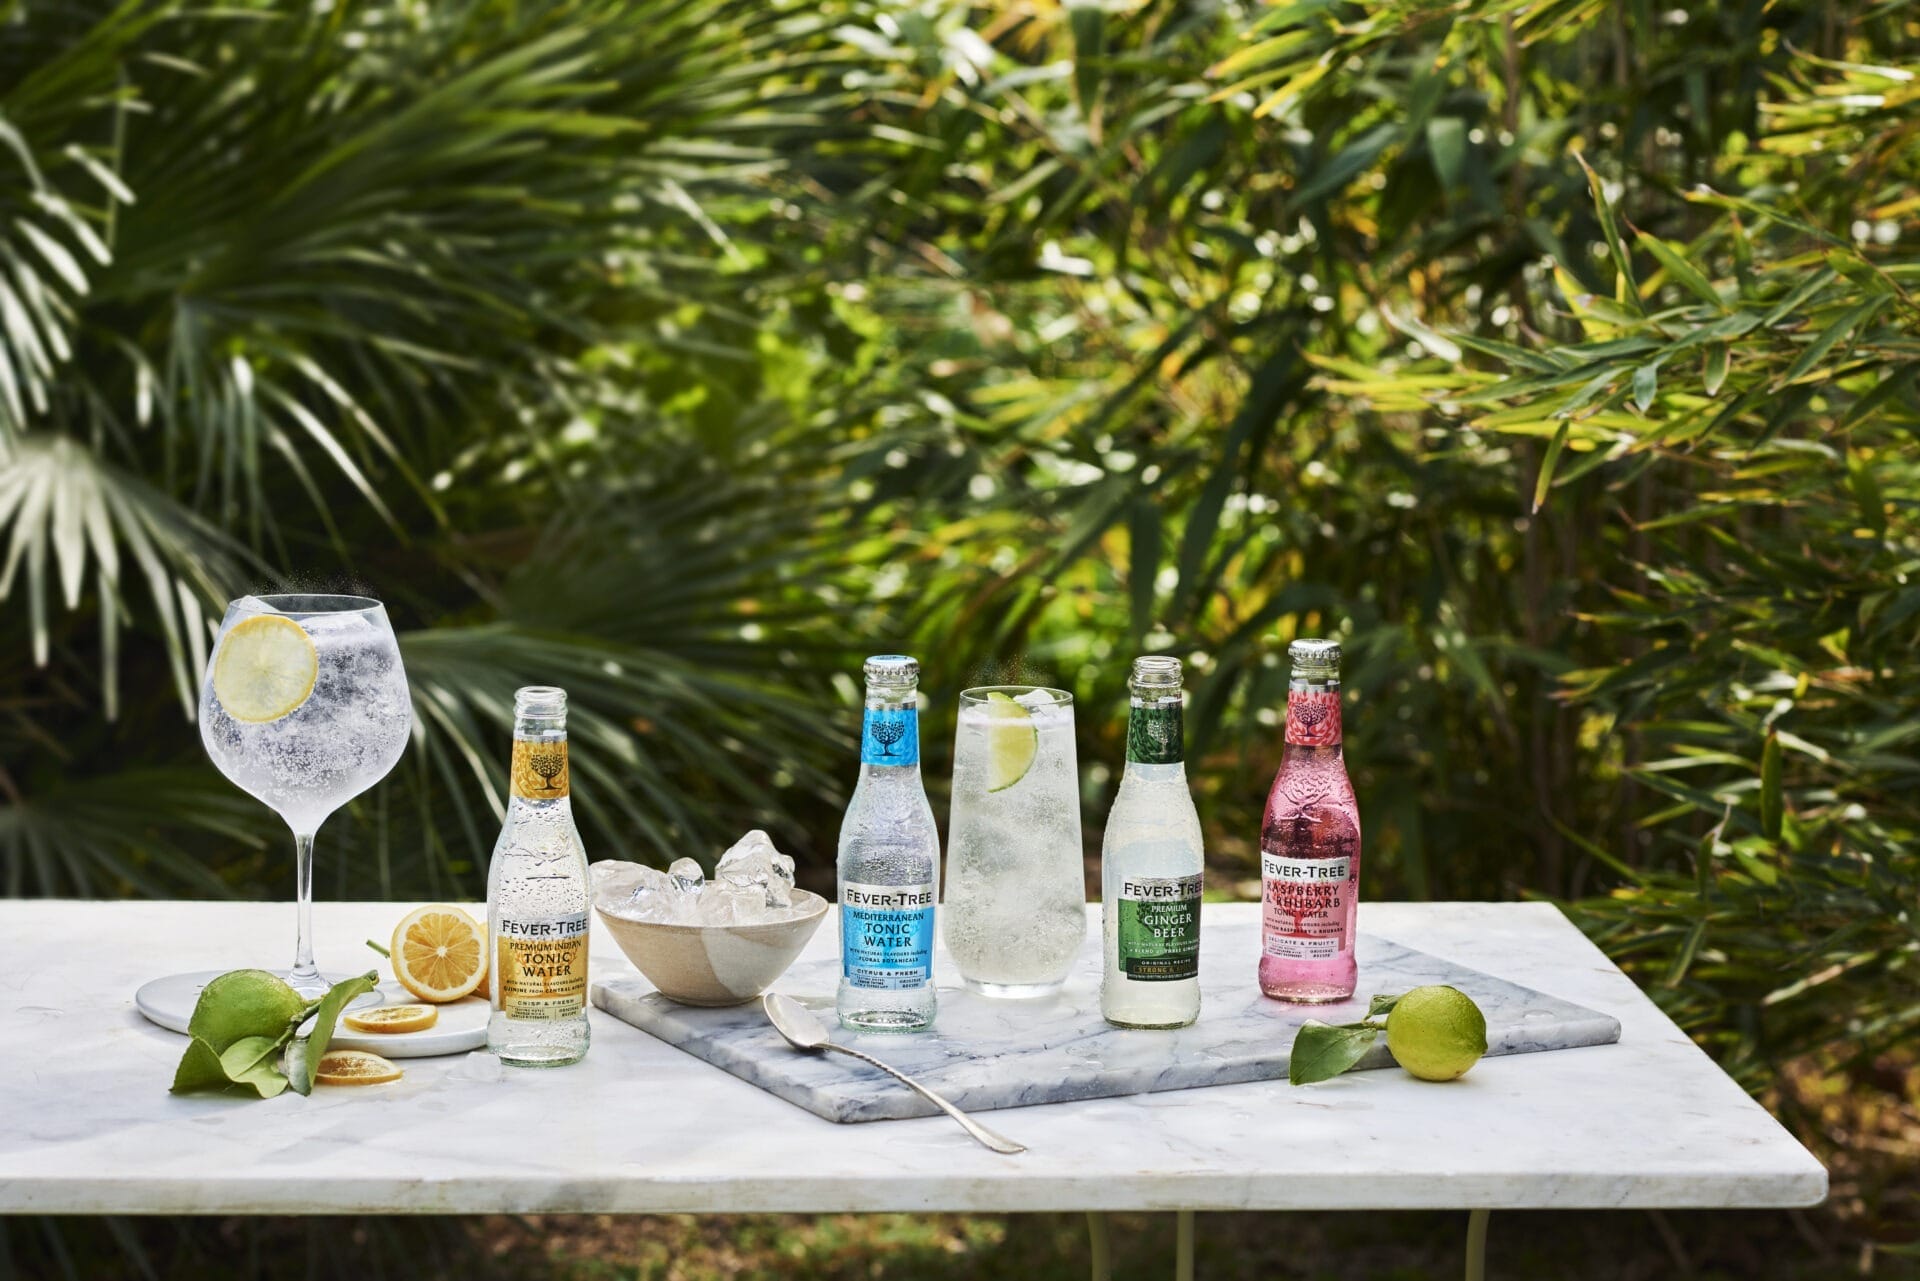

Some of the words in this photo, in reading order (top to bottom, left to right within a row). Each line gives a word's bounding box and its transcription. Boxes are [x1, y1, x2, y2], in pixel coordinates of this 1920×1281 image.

[1264, 859, 1345, 878] FEVER-TREE
[1266, 880, 1339, 897] RASPBERRY
[847, 888, 932, 906] FEVER-TREE
[1276, 896, 1341, 909] RHUBARB
[1151, 904, 1187, 913] PREMIUM
[1274, 907, 1296, 918] TONIC
[1299, 910, 1328, 918] WATER
[853, 911, 924, 922] MEDITERRANEAN
[1144, 913, 1192, 925] GINGER
[502, 918, 587, 936] FEVER-TREE
[865, 922, 910, 934] TONIC
[1153, 927, 1185, 938] BEER
[510, 942, 552, 951] PREMIUM
[554, 939, 582, 951] INDIAN
[864, 935, 912, 948] WATER
[524, 952, 570, 965] TONIC
[522, 965, 571, 977] WATER
[857, 968, 883, 976] CITRUS
